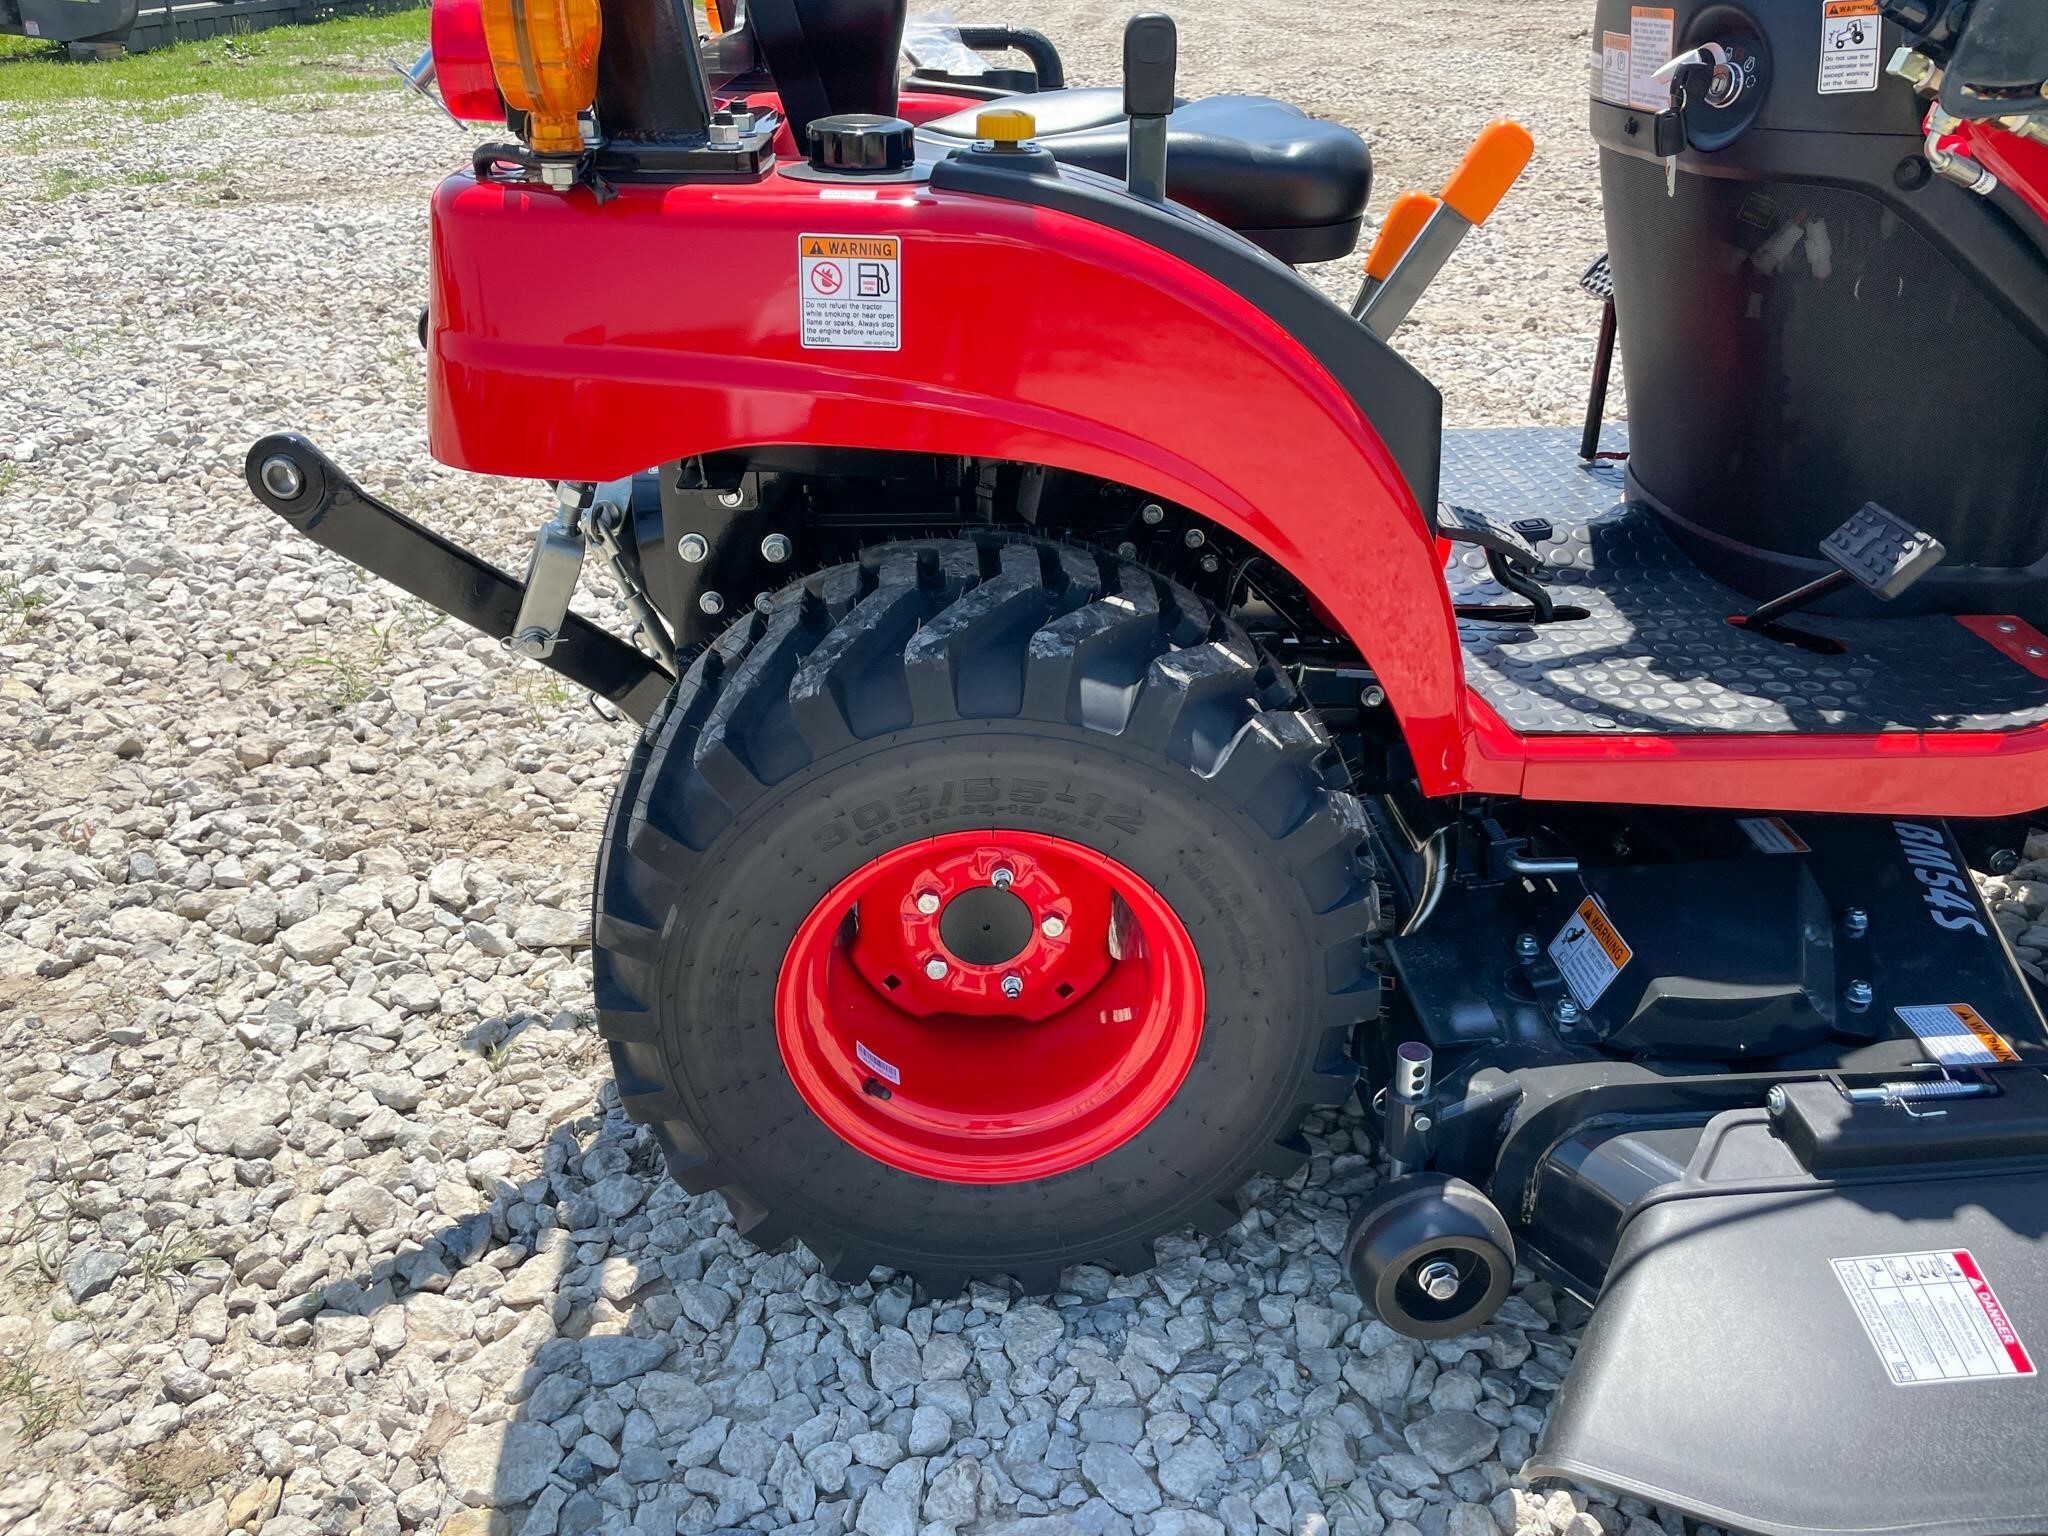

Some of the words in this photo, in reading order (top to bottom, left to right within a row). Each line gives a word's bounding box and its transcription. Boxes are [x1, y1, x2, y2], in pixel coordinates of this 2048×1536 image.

[829, 242, 891, 256] WARNING
[1892, 821, 1988, 936] BM54S
[1590, 916, 1624, 960] WARNING
[1970, 1021, 2015, 1062] WARNIN
[1844, 1272, 1858, 1291] death
[1859, 1302, 1876, 1326] serious
[1847, 1264, 1863, 1285] Failure
[1862, 1296, 1881, 1319] comply
[1877, 1321, 1888, 1333] will
[1884, 1335, 1899, 1353] result
[1977, 1291, 2014, 1345] DANGER
